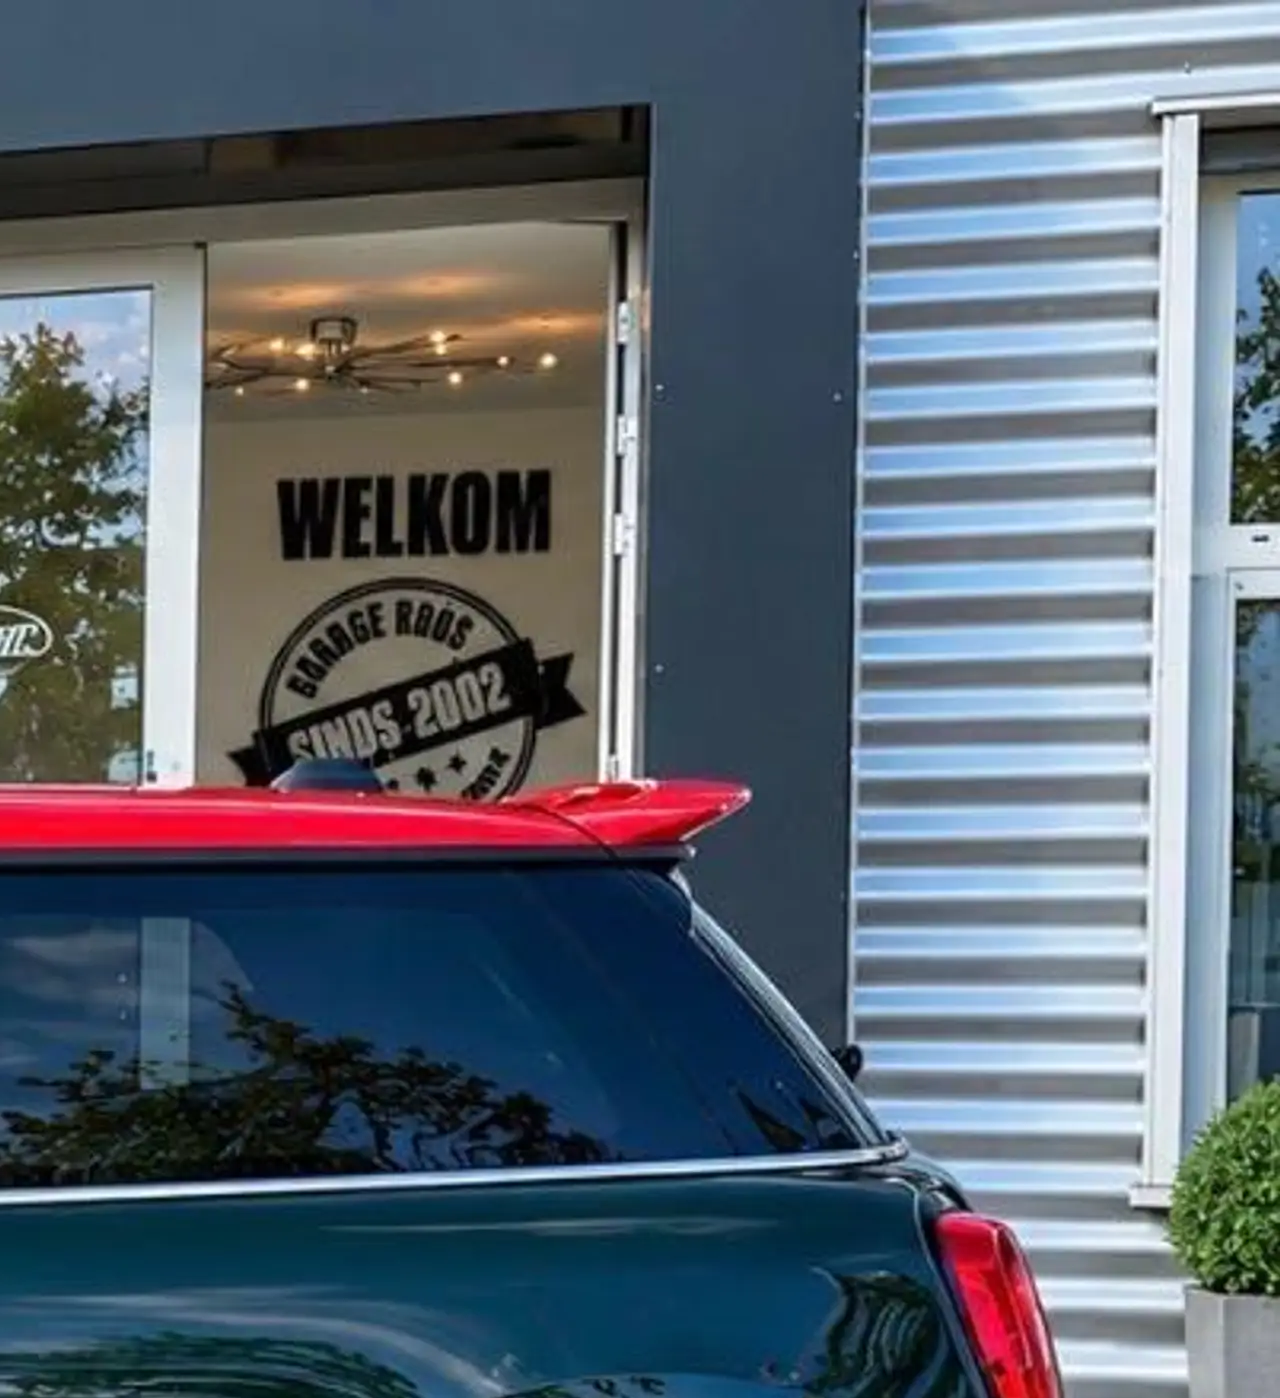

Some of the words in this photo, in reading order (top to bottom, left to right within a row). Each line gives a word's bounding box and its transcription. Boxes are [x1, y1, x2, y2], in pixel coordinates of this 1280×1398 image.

[276, 469, 552, 561] WELKOM
[285, 601, 387, 699] GARAGE
[286, 698, 402, 761] SINDS
[406, 660, 512, 740] 2002
